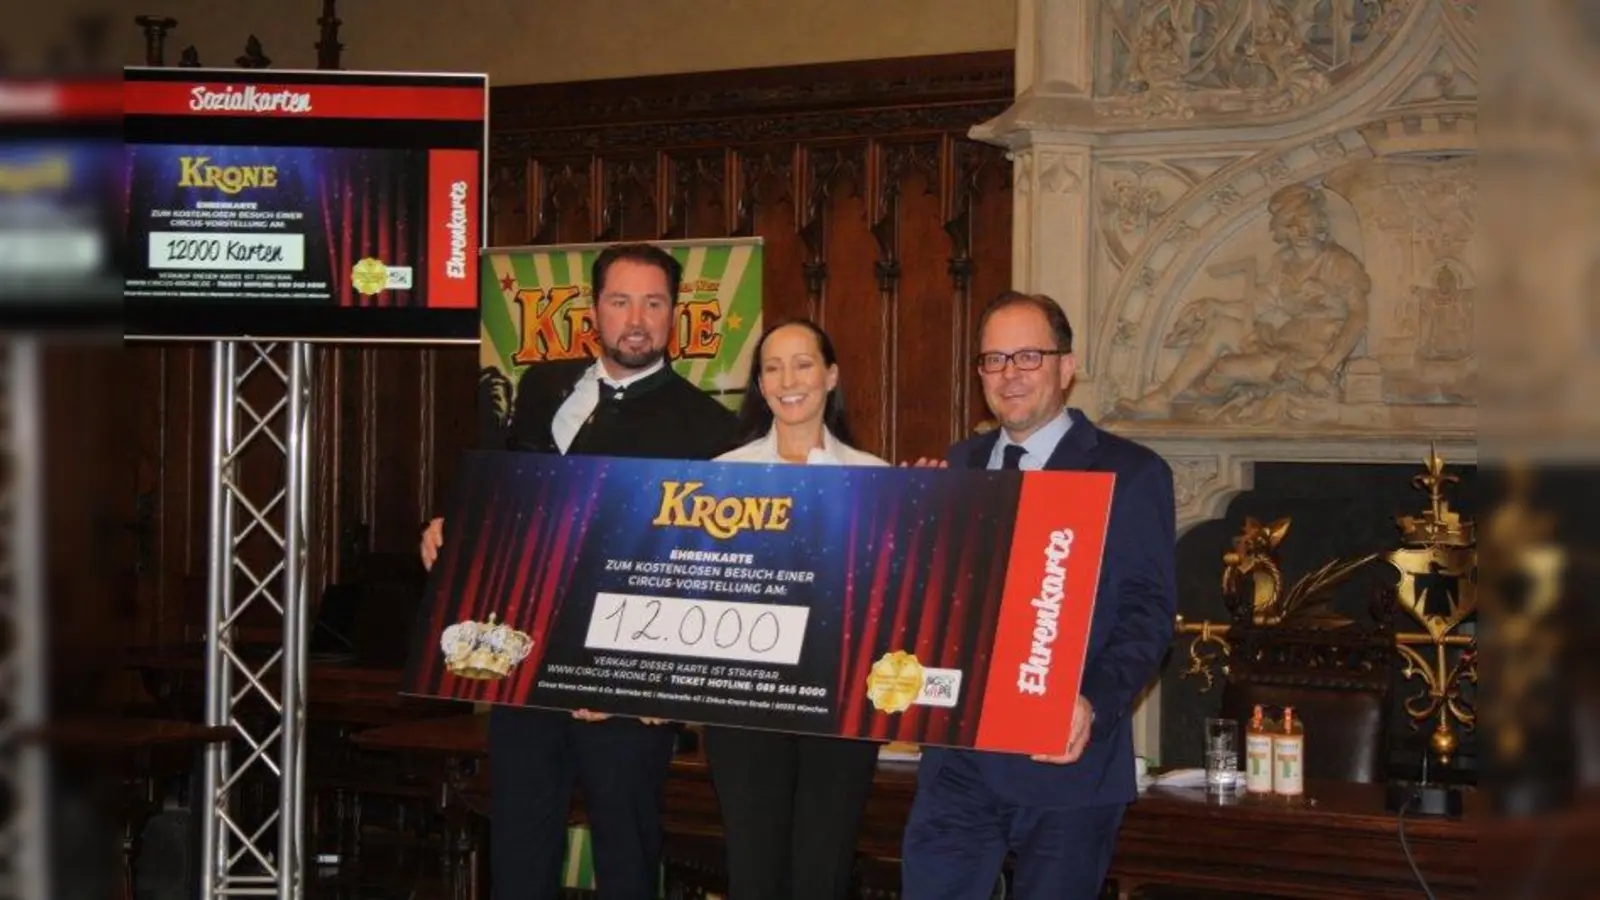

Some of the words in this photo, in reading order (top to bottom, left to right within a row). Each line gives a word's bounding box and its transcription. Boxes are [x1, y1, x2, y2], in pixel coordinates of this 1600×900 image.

[189, 86, 312, 112] Sozialkarten
[178, 156, 278, 194] KRONE
[446, 180, 468, 280] Ehrenkarte
[167, 239, 221, 262] 12000
[226, 239, 284, 263] Karten
[652, 479, 793, 539] KRONE
[605, 559, 632, 572] ZUM
[634, 561, 721, 578] KOSTENLOSEN
[723, 567, 774, 580] BESUCH
[776, 570, 815, 583] EINER
[669, 549, 754, 565] EHRENKARTE
[628, 575, 762, 595] CIRCUS-VORSTELLUNG
[764, 585, 788, 596] AM:
[605, 598, 780, 654] 12.000
[1017, 528, 1074, 696] Ehrenkarte
[547, 663, 662, 682] WWW.CIRCUS-KRONE.DE
[671, 674, 706, 687] TICKET
[707, 678, 754, 691] HOTLINE:
[755, 682, 776, 693] 089
[778, 684, 797, 695] 545
[798, 686, 827, 697] 8000
[594, 655, 638, 668] VERKAUF
[639, 659, 674, 672] DIESER
[676, 663, 709, 675] KARTE
[710, 666, 726, 676] IST
